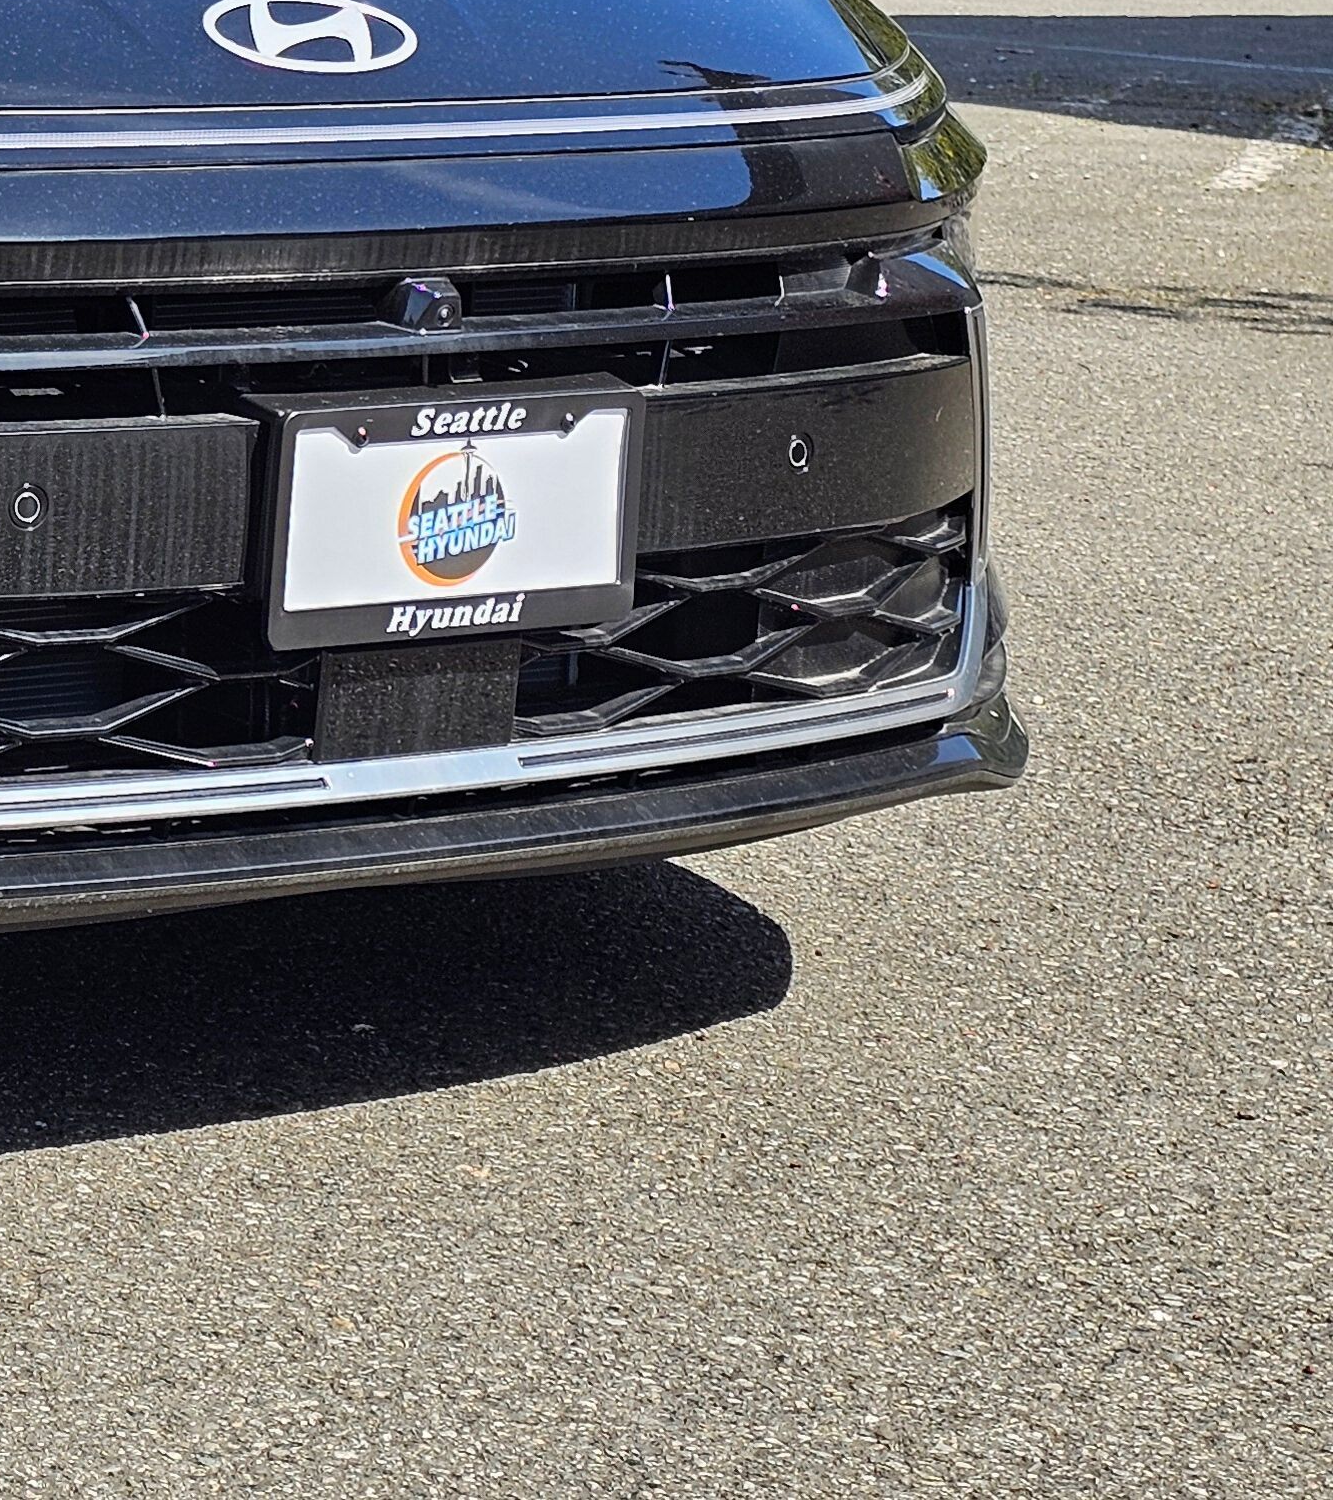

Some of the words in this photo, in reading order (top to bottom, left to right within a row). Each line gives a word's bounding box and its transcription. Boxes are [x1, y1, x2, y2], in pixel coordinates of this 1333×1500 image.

[411, 403, 526, 437] Seattle
[409, 495, 496, 539] SEATTLE
[416, 511, 515, 564] HYUNDAI
[386, 594, 525, 637] Hyundai
